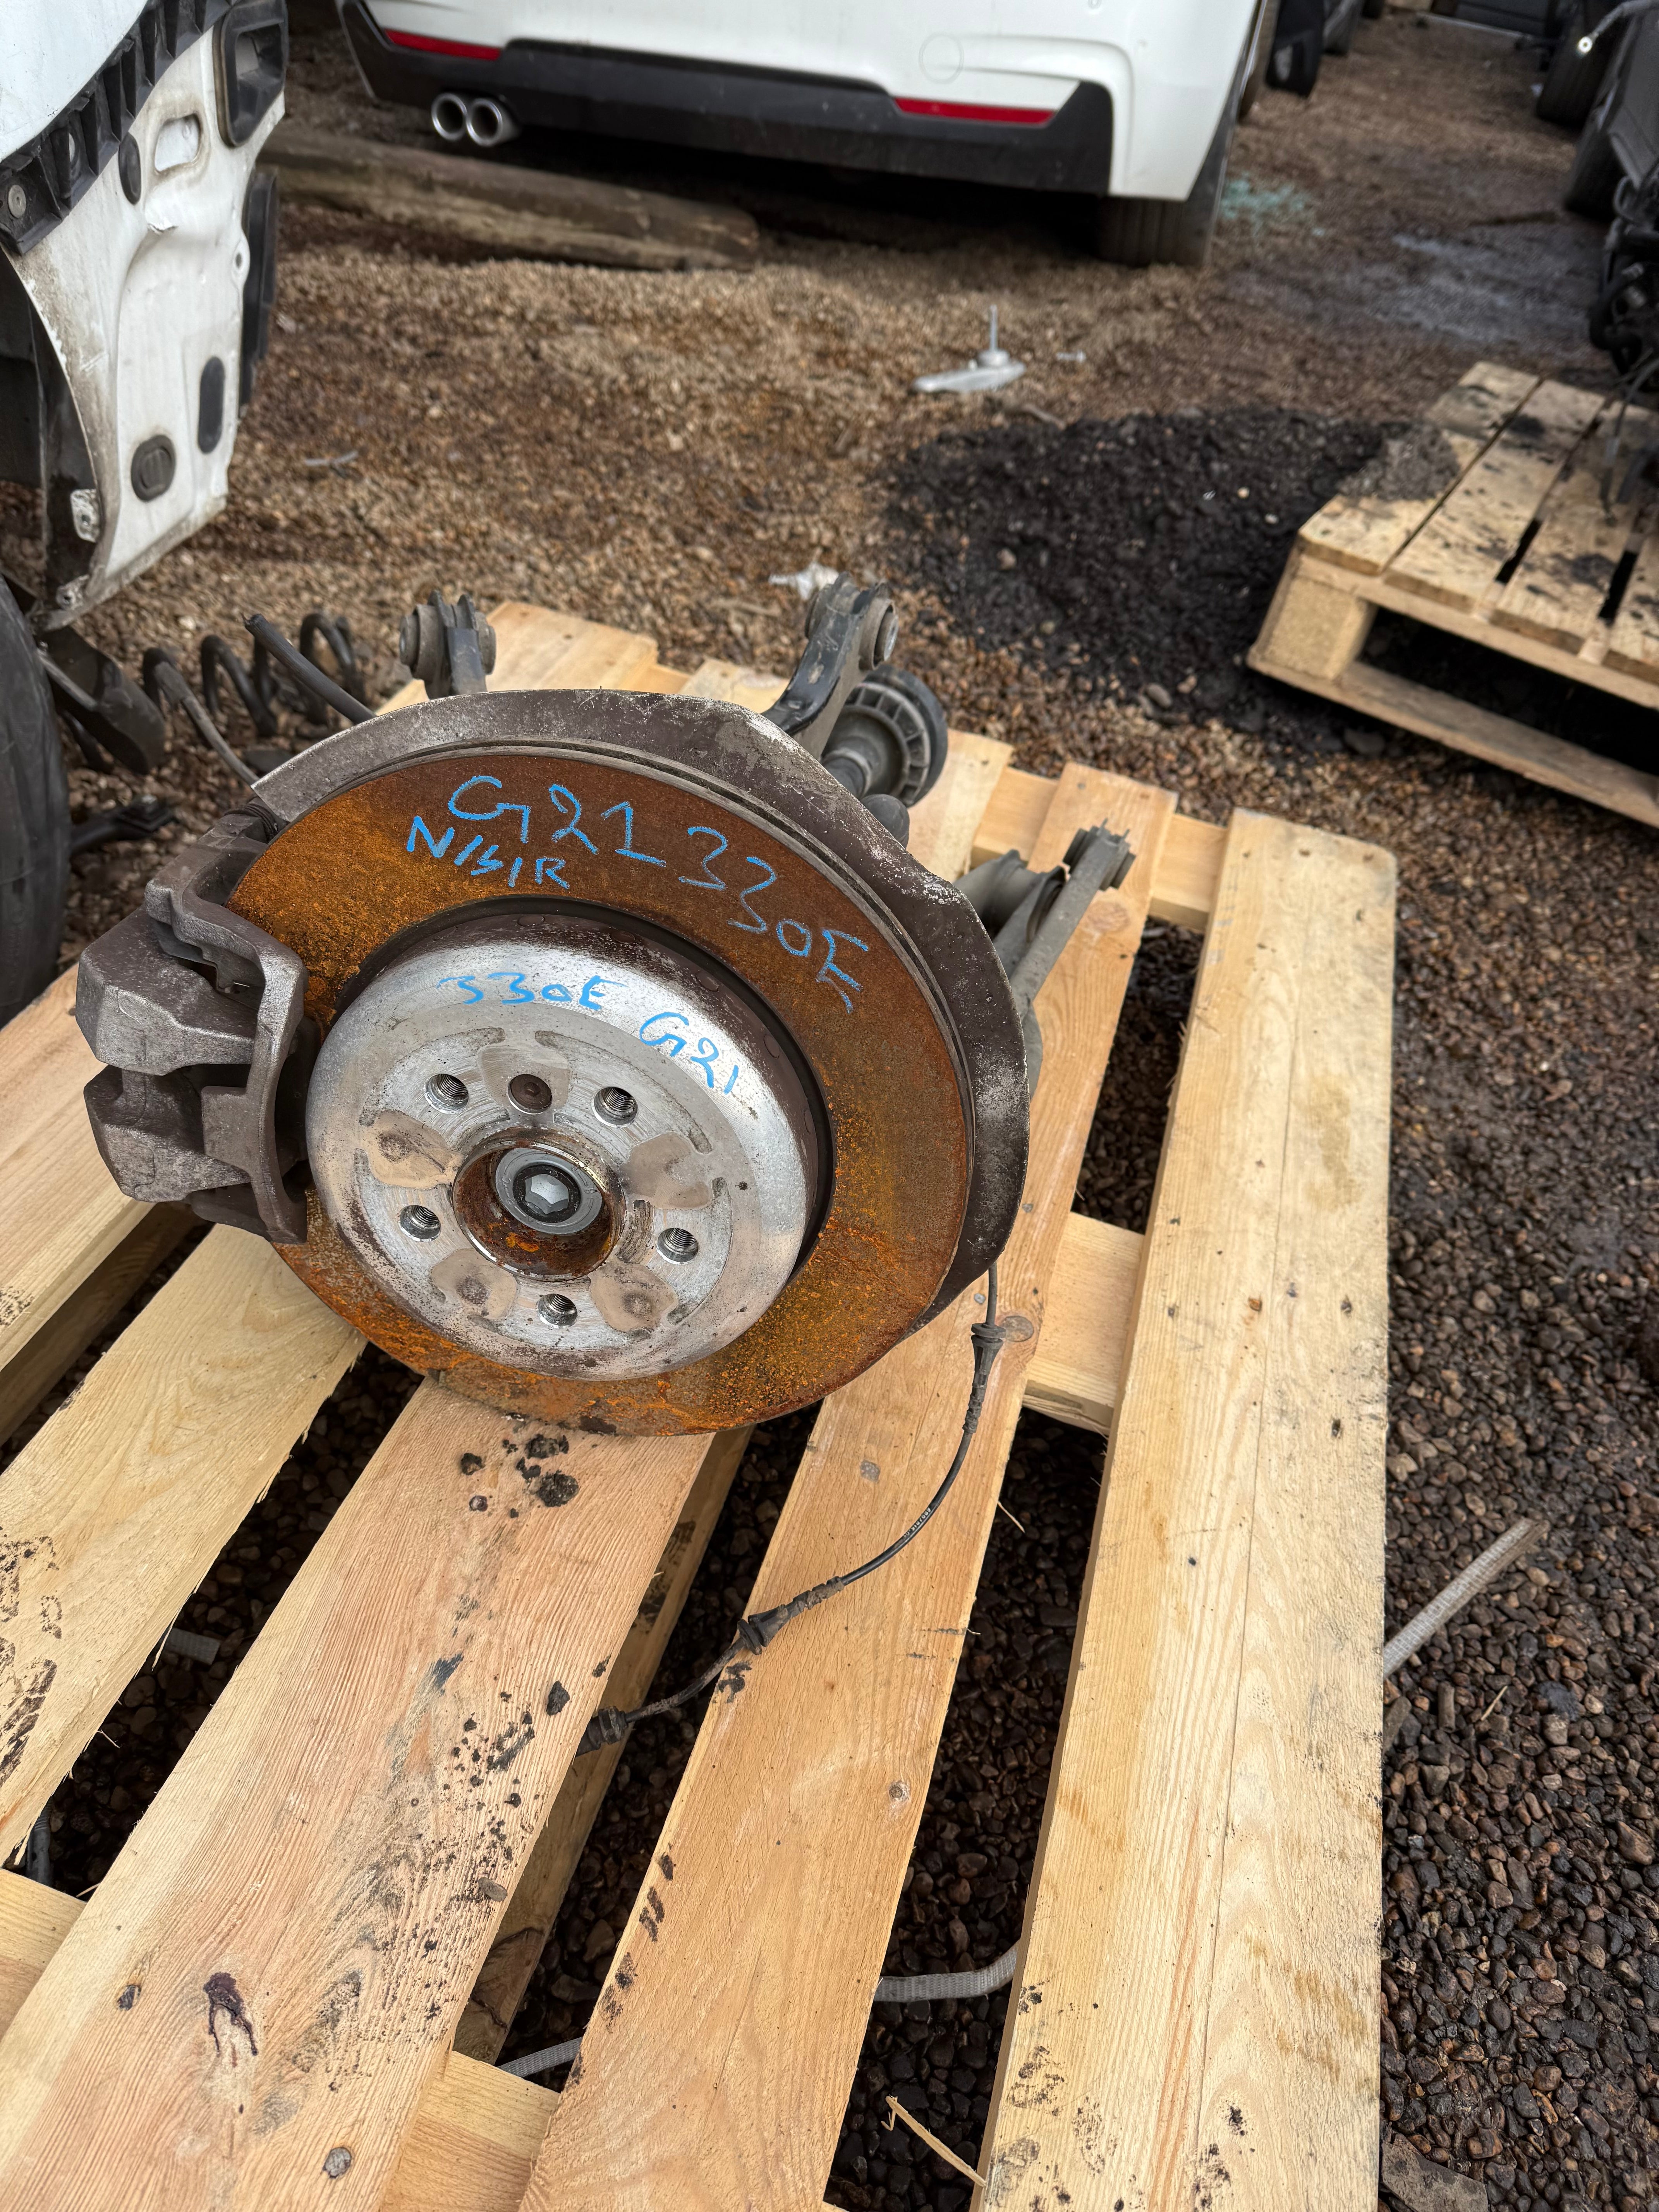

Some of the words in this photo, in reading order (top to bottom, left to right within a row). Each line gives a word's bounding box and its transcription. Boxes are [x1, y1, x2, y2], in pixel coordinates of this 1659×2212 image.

[448, 775, 666, 867] G21
[678, 826, 869, 1014] 330E
[639, 1012, 739, 1094] G21
